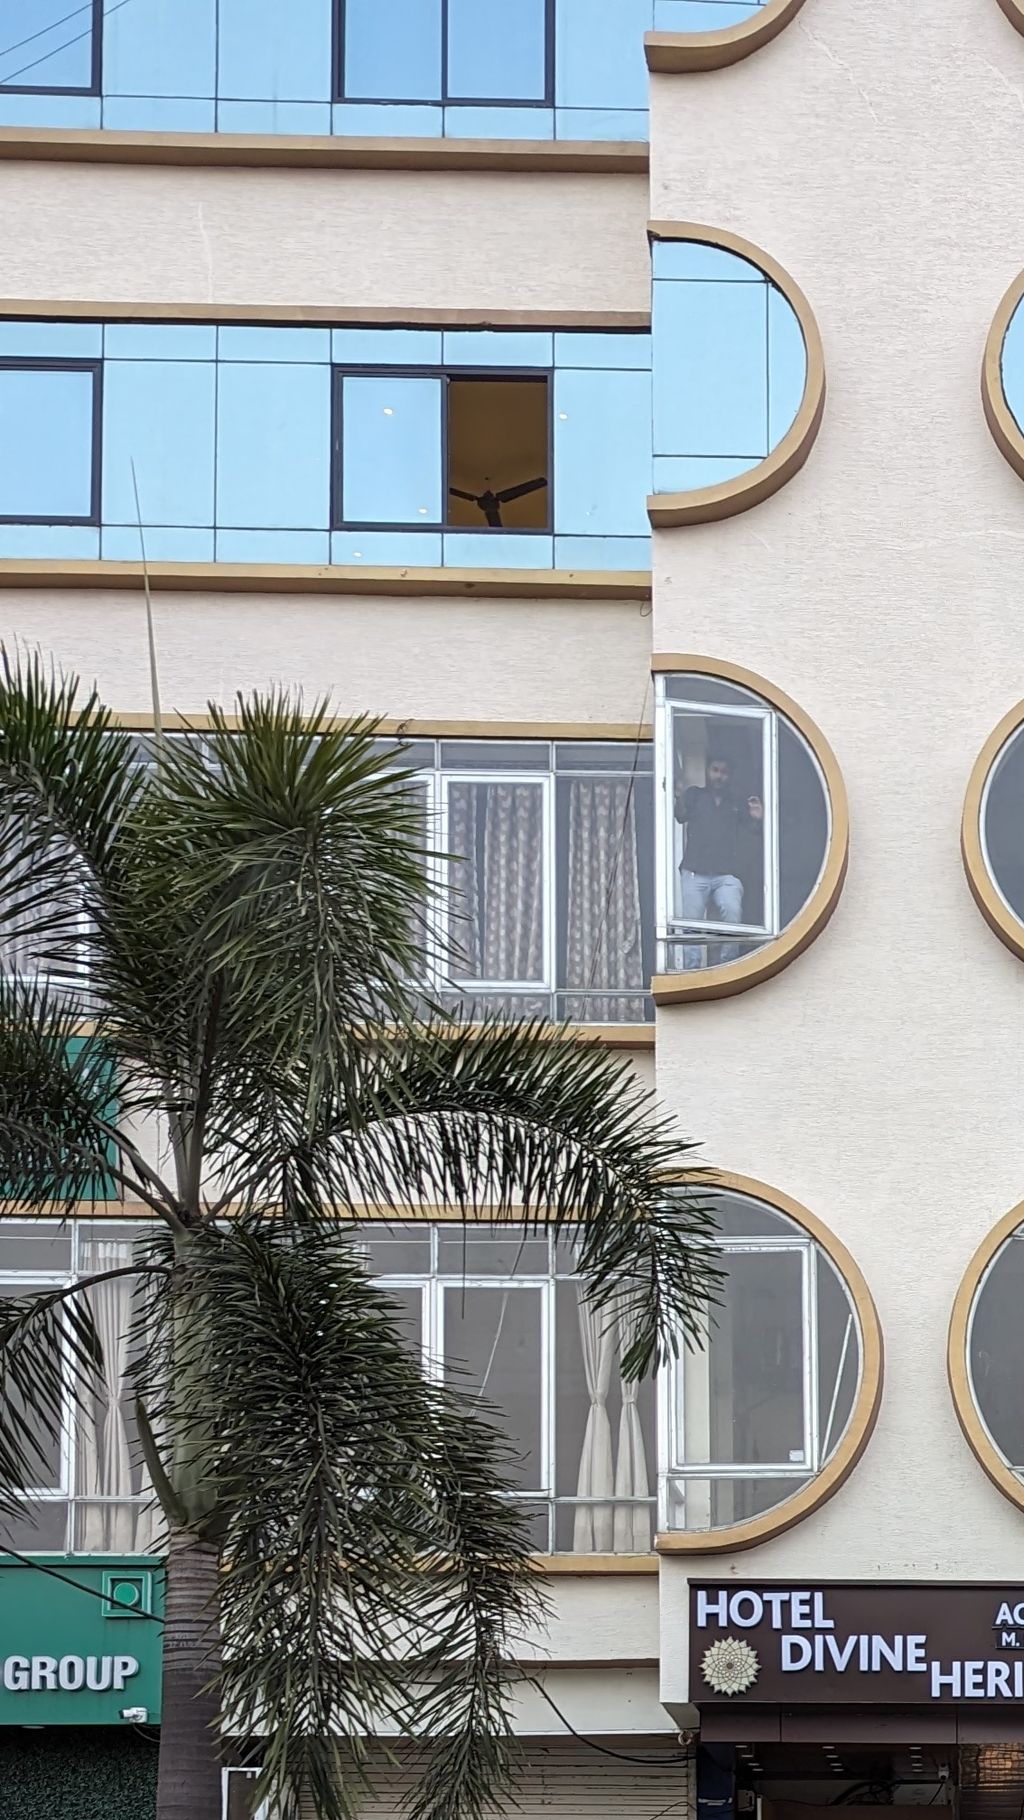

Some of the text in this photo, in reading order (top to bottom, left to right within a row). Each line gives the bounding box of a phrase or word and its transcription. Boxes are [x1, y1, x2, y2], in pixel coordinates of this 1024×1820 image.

[697, 1590, 834, 1629] HOTEL
[781, 1635, 927, 1672] DIVINE
[1001, 1633, 1020, 1648] M.
[3, 1655, 140, 1692] GROUP
